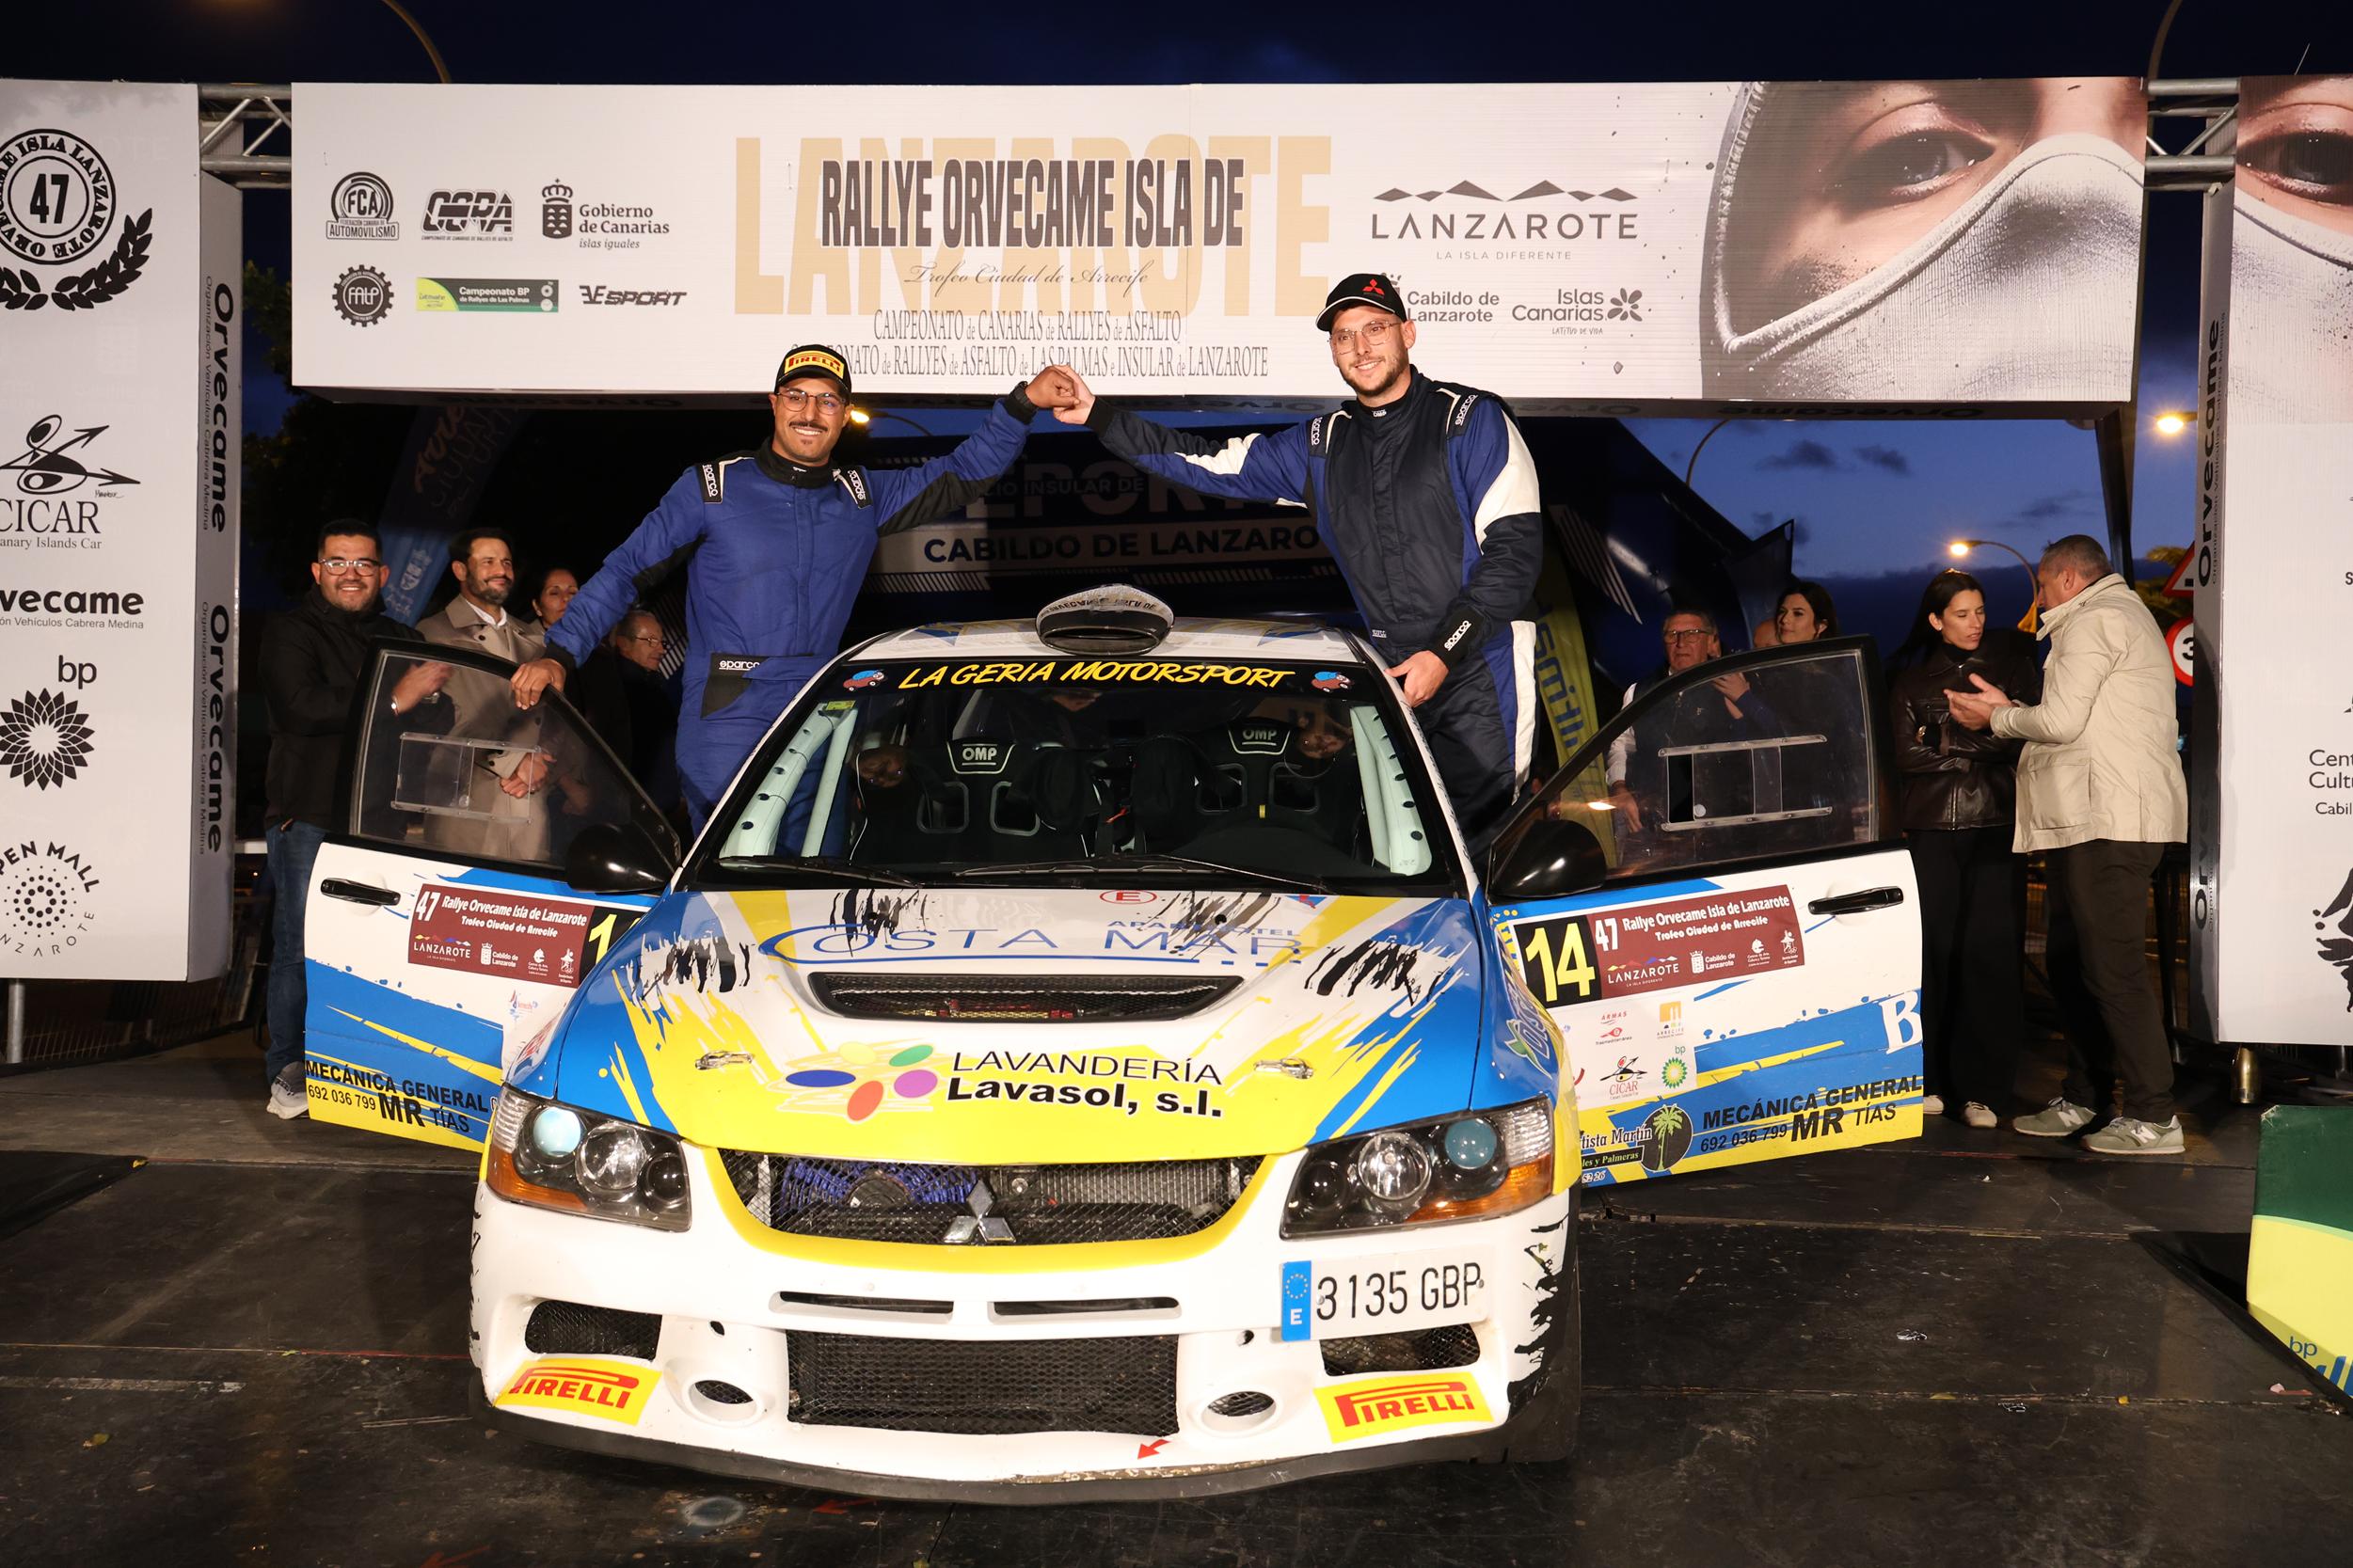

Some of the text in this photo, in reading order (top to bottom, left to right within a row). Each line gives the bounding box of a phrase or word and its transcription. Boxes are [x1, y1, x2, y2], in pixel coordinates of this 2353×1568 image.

[15, 135, 109, 258] ISLA LANZAROTE
[30, 173, 69, 224] 47
[347, 188, 378, 215] FCA
[580, 204, 653, 217] Gobierno
[822, 158, 1245, 249] RALLYE ORVECAME ISLA DE
[329, 225, 396, 238] AUTOMOVILISMO
[580, 220, 670, 234] de Canarias
[734, 135, 1332, 316] LANZAROTE
[1372, 213, 1639, 239] LANZAROTE
[580, 238, 640, 250] islas iguales
[1437, 251, 1571, 260] LA ISLA DIFERENTE
[459, 287, 530, 297] Campeonato BP
[904, 259, 1155, 297] Trofeo Ciudad de Arrecife
[1407, 291, 1500, 306] Cabildo de
[1557, 289, 1604, 305] Islas
[203, 276, 213, 359] Organización
[874, 309, 1182, 341] CAMPEONATO de CANARIAS de RALLYES de ASFALTO
[1407, 308, 1493, 323] Lanzarote
[1511, 305, 1605, 322] Canarias
[787, 354, 842, 374] PIRELLI
[882, 353, 891, 375] de
[893, 344, 947, 375] RALLYES
[949, 353, 959, 375] de
[961, 345, 1017, 376] ASFALTO
[1019, 354, 1028, 375] de
[1031, 346, 1055, 376] LAS
[1117, 346, 1175, 376] INSULAR
[1177, 355, 1186, 377] de
[1188, 346, 1268, 376] LANZAROTE
[203, 364, 213, 426] Vehículos
[212, 283, 234, 532] Orvecame
[1455, 394, 1478, 425] sparco
[203, 429, 212, 482] Cabrera
[2199, 319, 2218, 588] Orvecame
[0, 499, 101, 533] CICAR
[36, 537, 102, 549] Islands Car
[924, 530, 1139, 564] CABILDO DE
[0, 589, 144, 615] vecame
[15, 616, 62, 627] Vehículos
[65, 617, 105, 627] Cabrera
[108, 619, 144, 629] Medina
[1444, 620, 1471, 651] sparco
[200, 602, 209, 685] Organización
[57, 655, 98, 689] bp
[898, 660, 1297, 689] LA GERIA MOTORSPORT
[208, 605, 230, 852] Orvecame
[1243, 727, 1278, 741] OMP
[962, 747, 997, 762] OMP
[47, 841, 100, 893] MALL
[415, 891, 588, 927] 47 Rallye Orvecame Isla de Lanzarote
[1595, 895, 1789, 952] 47 Rallye Orvecame Isla de Lanzarote
[461, 915, 558, 939] Trofeo Ciudad de Arrecife
[1655, 915, 1769, 942] Trofeo Ciudad de Arrecife
[414, 942, 470, 958] LANZAROTE
[492, 951, 518, 961] Cabildo de
[1105, 929, 1302, 958] MAR
[491, 958, 517, 968] Lanzarote
[1525, 922, 1596, 1003] 14
[1608, 962, 1679, 984] LANZAROTE
[1705, 954, 1726, 963] Cabildo
[1706, 960, 1734, 971] Lanzarote
[1601, 1011, 1628, 1022] ARMAS
[1675, 1045, 1686, 1055] bp
[952, 1049, 1223, 1086] LAVANDERÍA
[306, 1060, 396, 1093] MECÁNICA
[403, 1079, 488, 1113] GENERAL
[309, 1085, 376, 1111] 692 036 799
[947, 1076, 1223, 1117] Lavasol, s.l.
[1609, 1081, 1638, 1096] CICAR
[378, 1093, 470, 1133] MR TÍAS
[1703, 1075, 1922, 1130] MECÁNICA GENERAL
[1611, 1123, 1652, 1145] Martín
[1791, 1102, 1897, 1143] MR TÍAS
[1701, 1123, 1788, 1153] 692 036 799
[1594, 1158, 1600, 1167] y
[1602, 1151, 1639, 1164] Palmeras
[1316, 1261, 1483, 1322] 3135 GBP
[1290, 1308, 1303, 1325] E
[2289, 1335, 2318, 1359] bp
[509, 1366, 640, 1409] PIRELLI
[1336, 1380, 1475, 1427] PIRELLI
